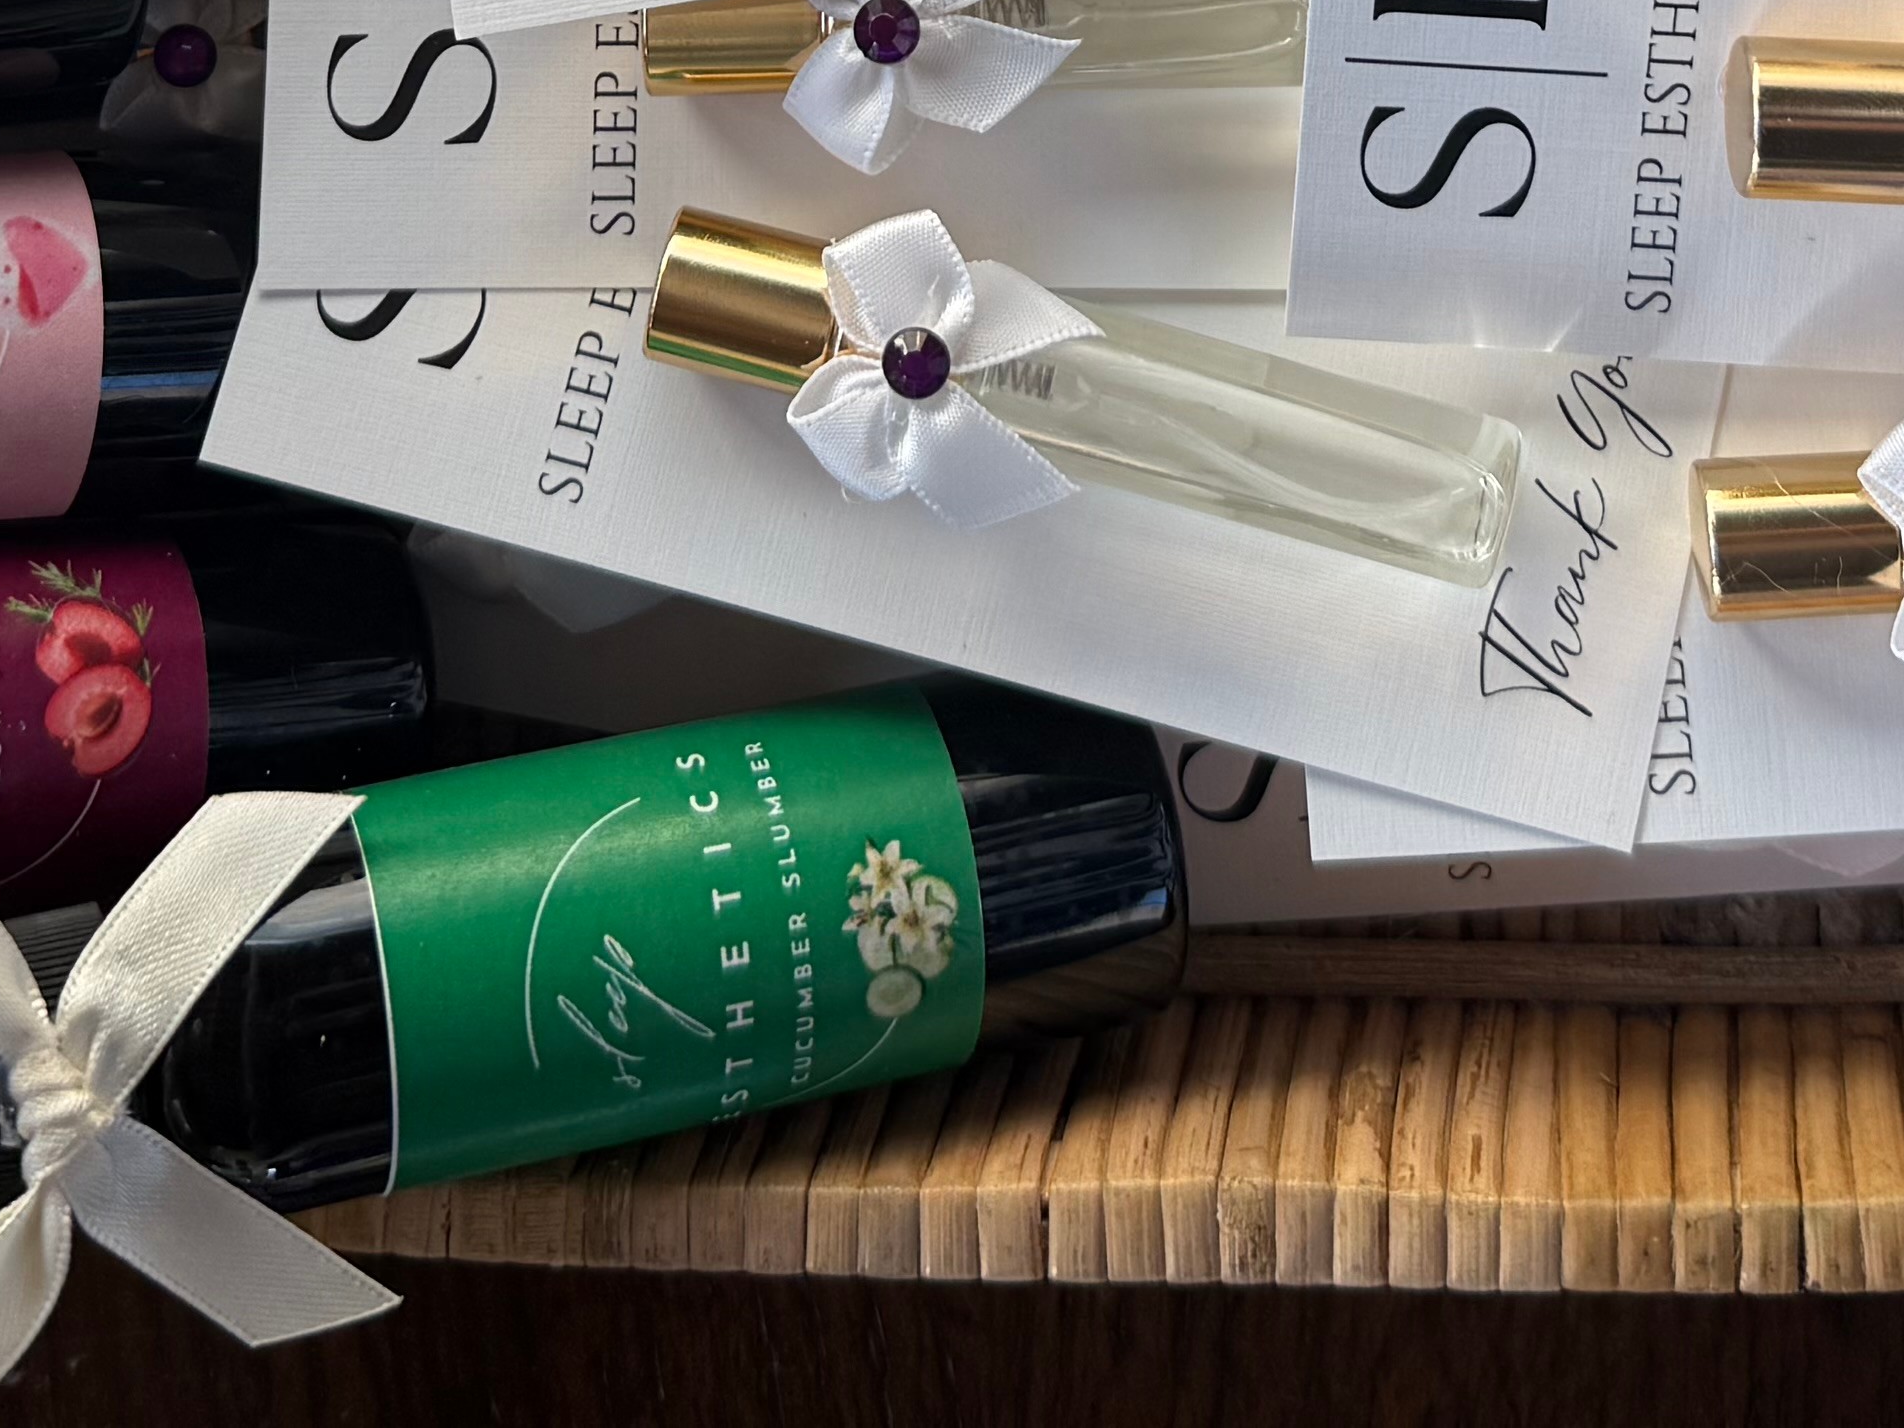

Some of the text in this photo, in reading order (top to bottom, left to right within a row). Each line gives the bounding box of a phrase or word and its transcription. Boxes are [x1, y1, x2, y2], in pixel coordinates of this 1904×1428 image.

[590, 71, 638, 236] SLEEP
[1624, 157, 1683, 314] SLEEP
[538, 331, 621, 503] SLEEP
[1478, 477, 1618, 717] Thank
[743, 740, 814, 1084] CUCUMBER SLUMBER
[557, 934, 715, 1090] sleep
